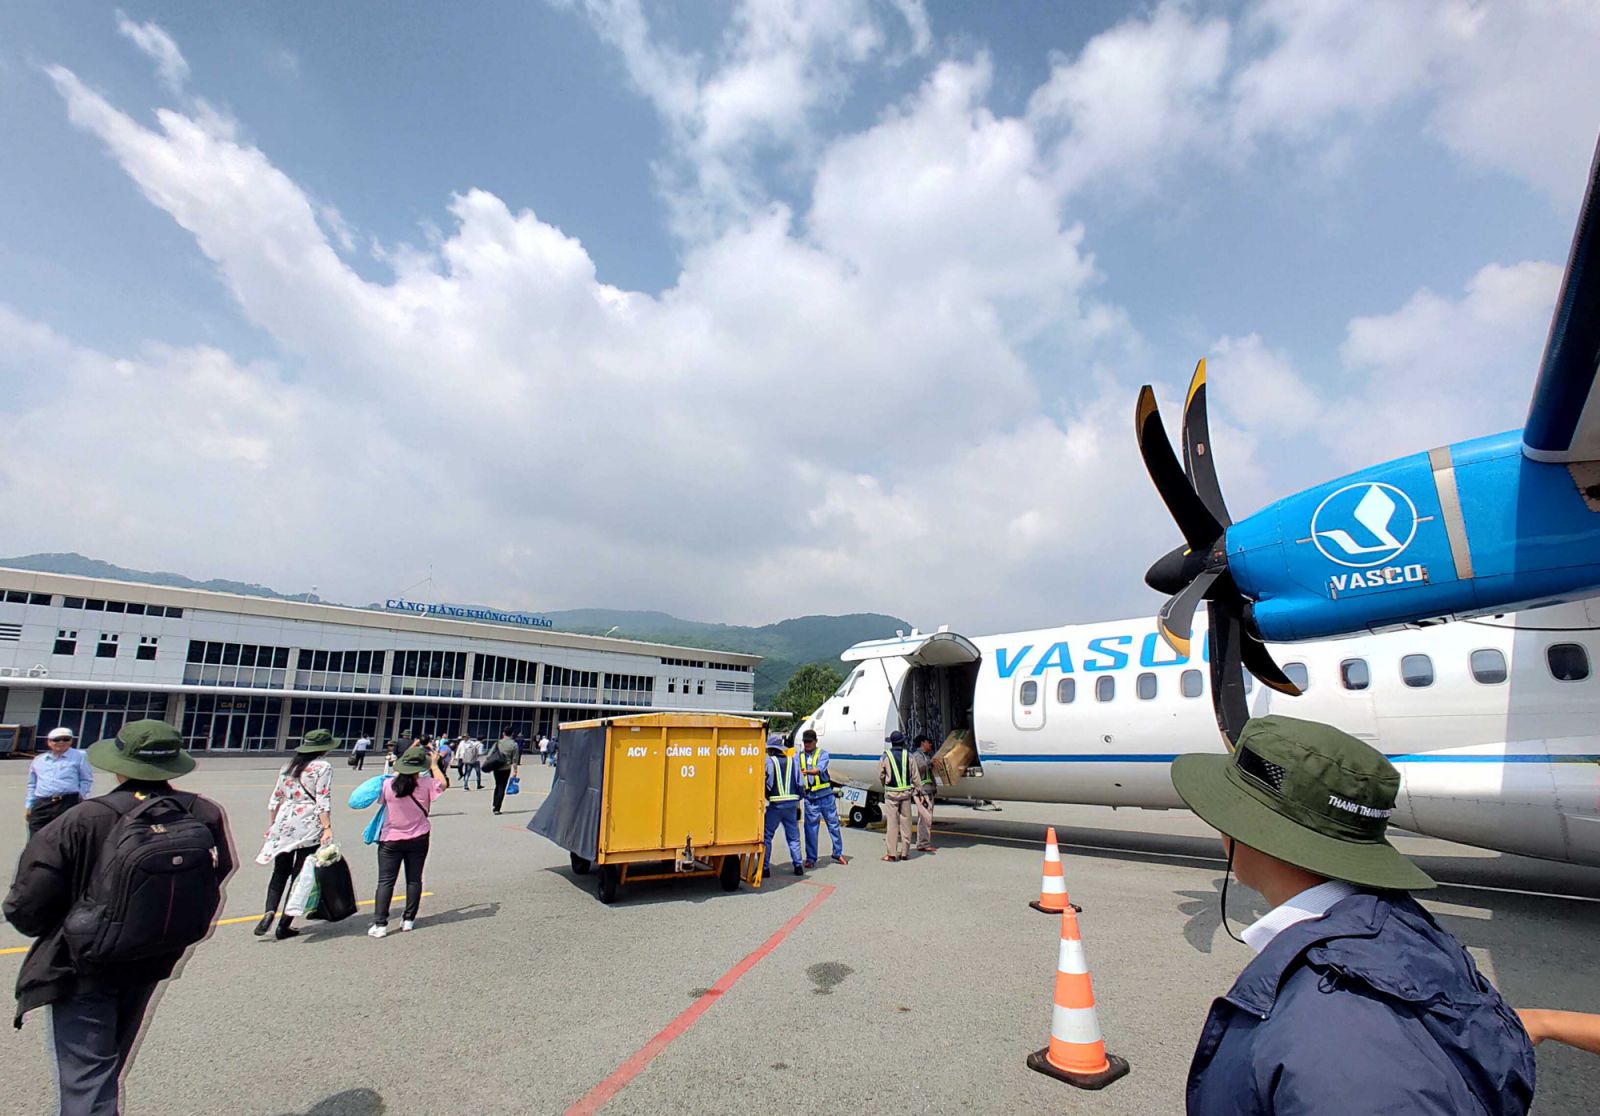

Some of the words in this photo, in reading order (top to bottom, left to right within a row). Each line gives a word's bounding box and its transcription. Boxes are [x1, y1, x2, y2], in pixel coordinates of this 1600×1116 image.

[1330, 564, 1424, 591] VASCO
[386, 597, 425, 612] CẢNG
[995, 629, 1209, 678] VASC
[627, 746, 648, 757] ACV
[665, 743, 692, 757] CẢNG
[697, 746, 711, 757] HK
[717, 744, 736, 756] CÔN
[740, 743, 760, 756] ĐẢO
[681, 765, 696, 778] 03
[1328, 795, 1359, 814] THANH
